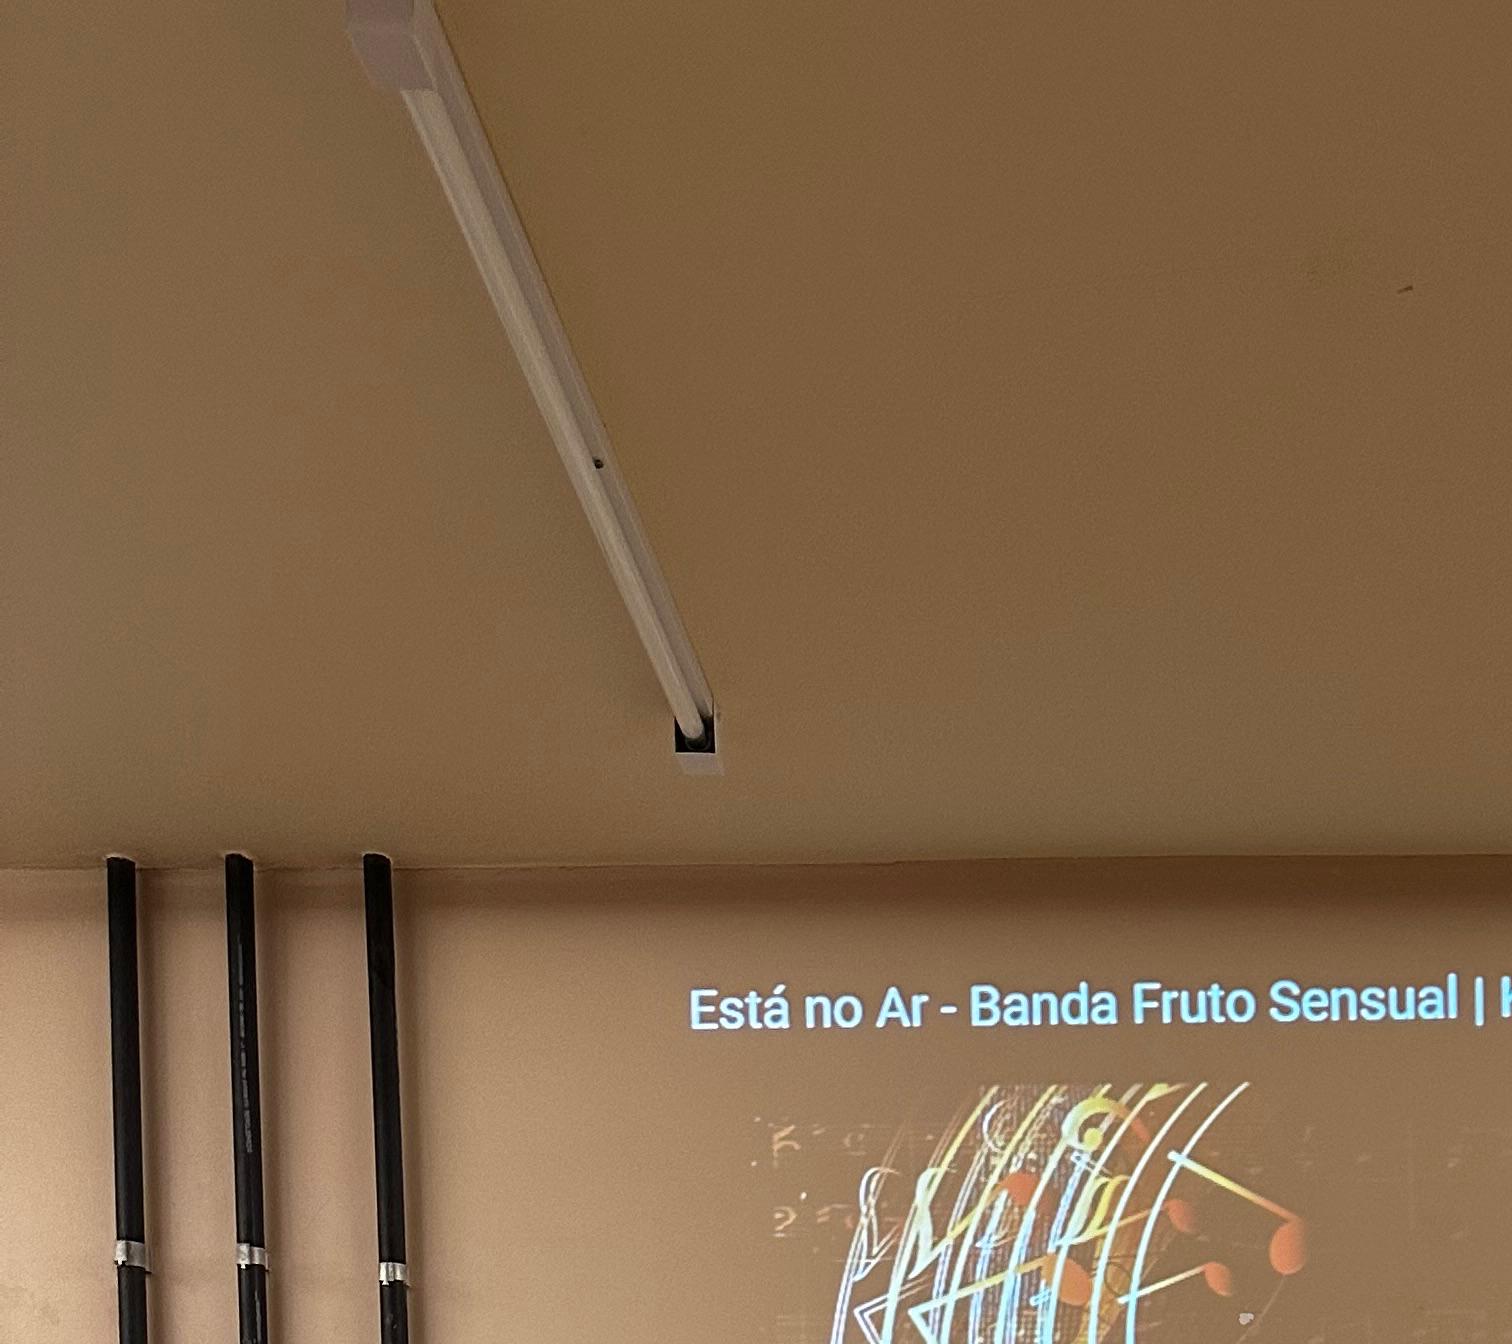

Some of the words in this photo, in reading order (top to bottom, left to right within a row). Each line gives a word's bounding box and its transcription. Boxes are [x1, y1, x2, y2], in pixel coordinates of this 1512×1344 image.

[690, 983, 790, 1031] Está
[804, 994, 864, 1030] no
[875, 985, 930, 1029] Ar
[939, 1004, 959, 1015] -
[969, 980, 1119, 1028] Banda
[1131, 981, 1257, 1026] Fruto
[1268, 971, 1459, 1023] Sensual
